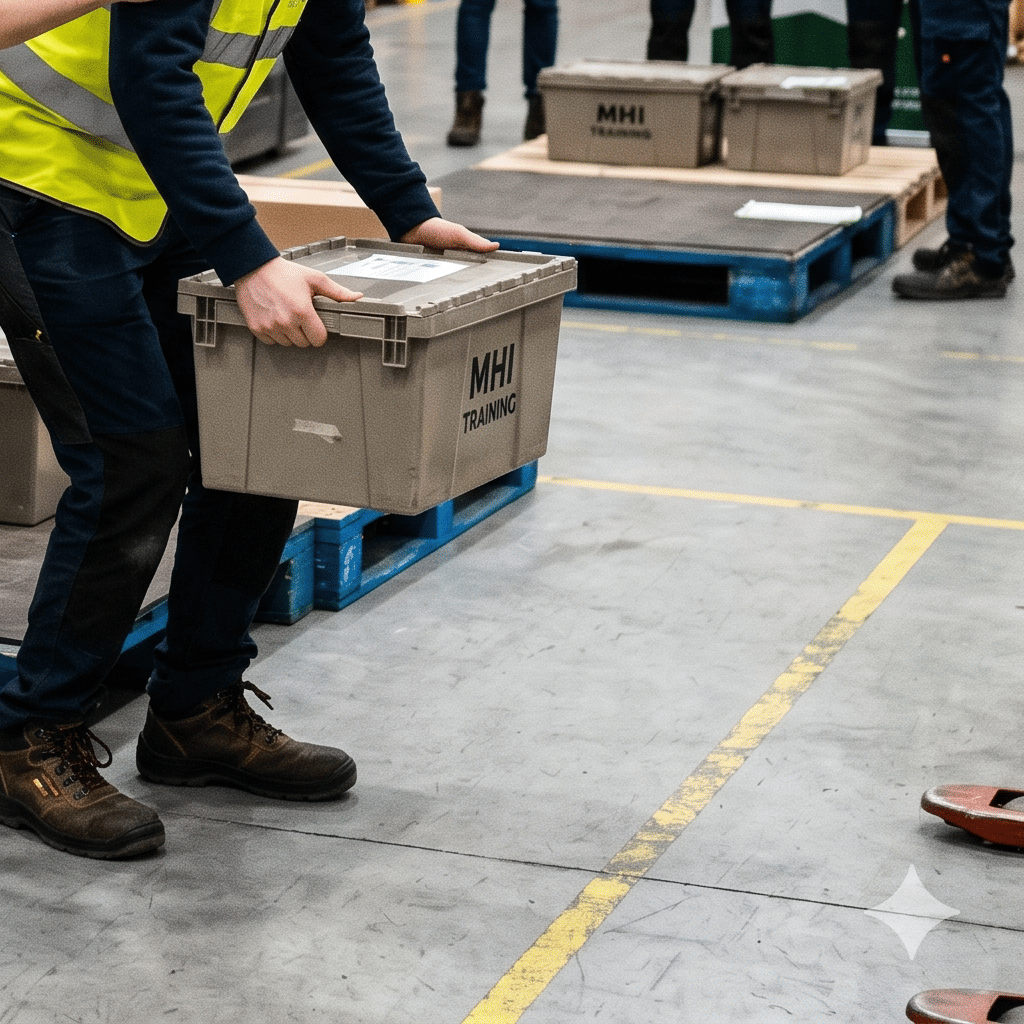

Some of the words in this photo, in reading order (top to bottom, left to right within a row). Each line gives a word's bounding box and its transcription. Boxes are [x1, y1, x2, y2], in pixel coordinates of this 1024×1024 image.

[596, 104, 645, 124] MHI
[469, 342, 516, 400] MHI
[462, 392, 517, 434] TRAINING
